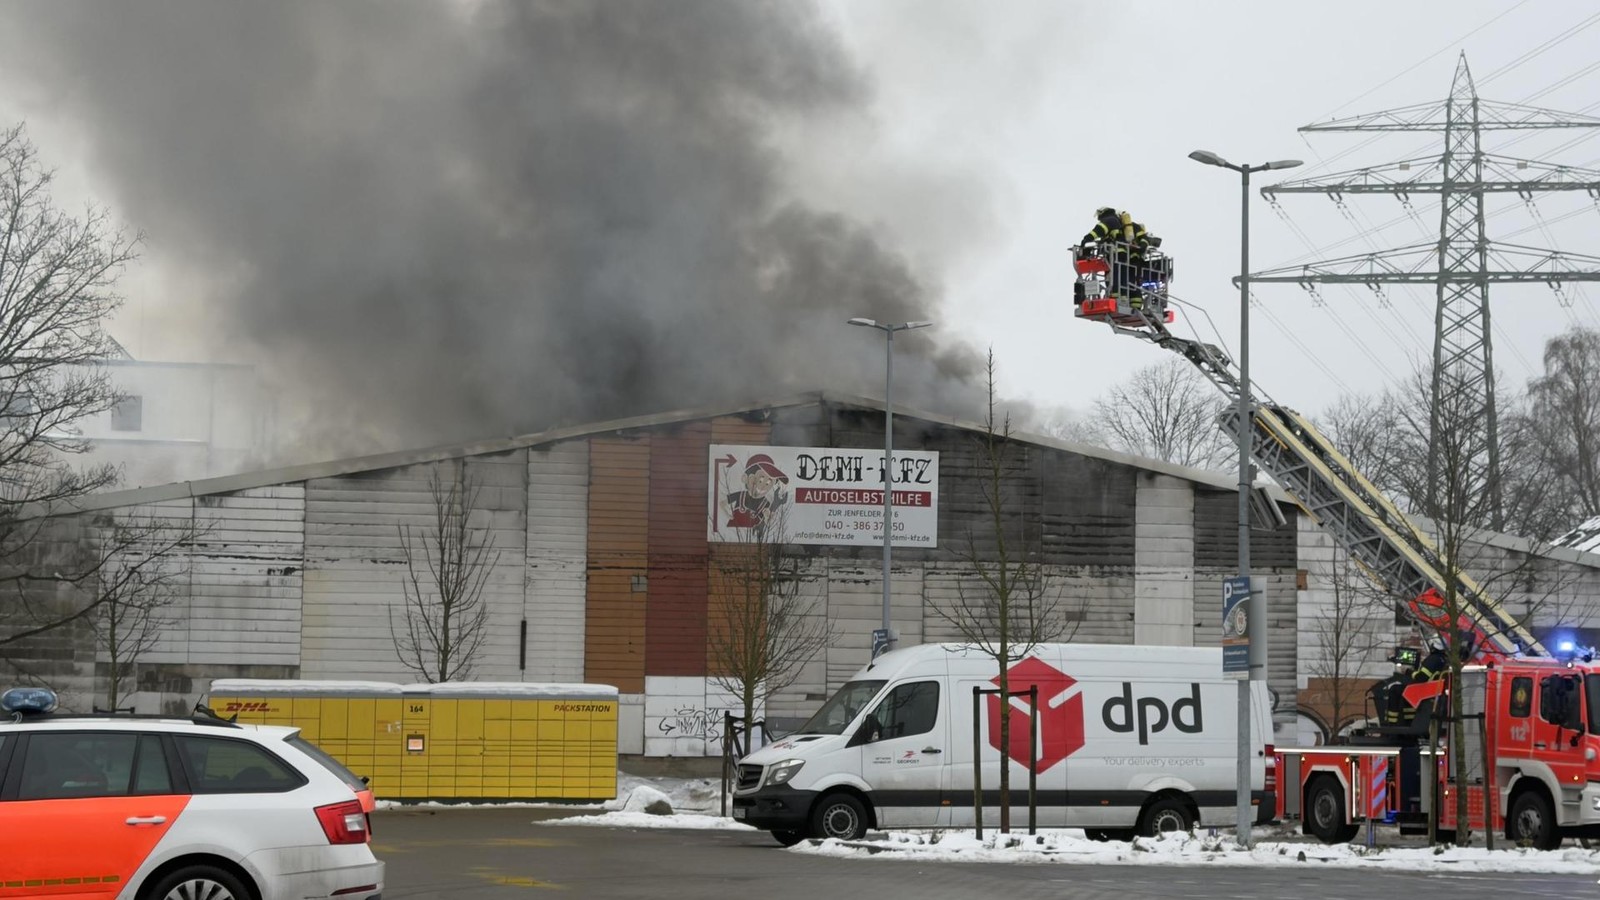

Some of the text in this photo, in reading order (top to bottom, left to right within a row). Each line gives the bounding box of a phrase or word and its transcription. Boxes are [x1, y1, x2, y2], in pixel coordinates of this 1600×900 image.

[825, 520, 843, 530] 040
[853, 521, 871, 531] 386
[226, 702, 270, 712] DHL
[410, 705, 424, 713] 164
[554, 704, 611, 712] PACKSTATION
[1102, 681, 1203, 745] dpd
[1511, 726, 1526, 741] 112
[1104, 757, 1126, 766] Your
[1128, 758, 1166, 767] delivery
